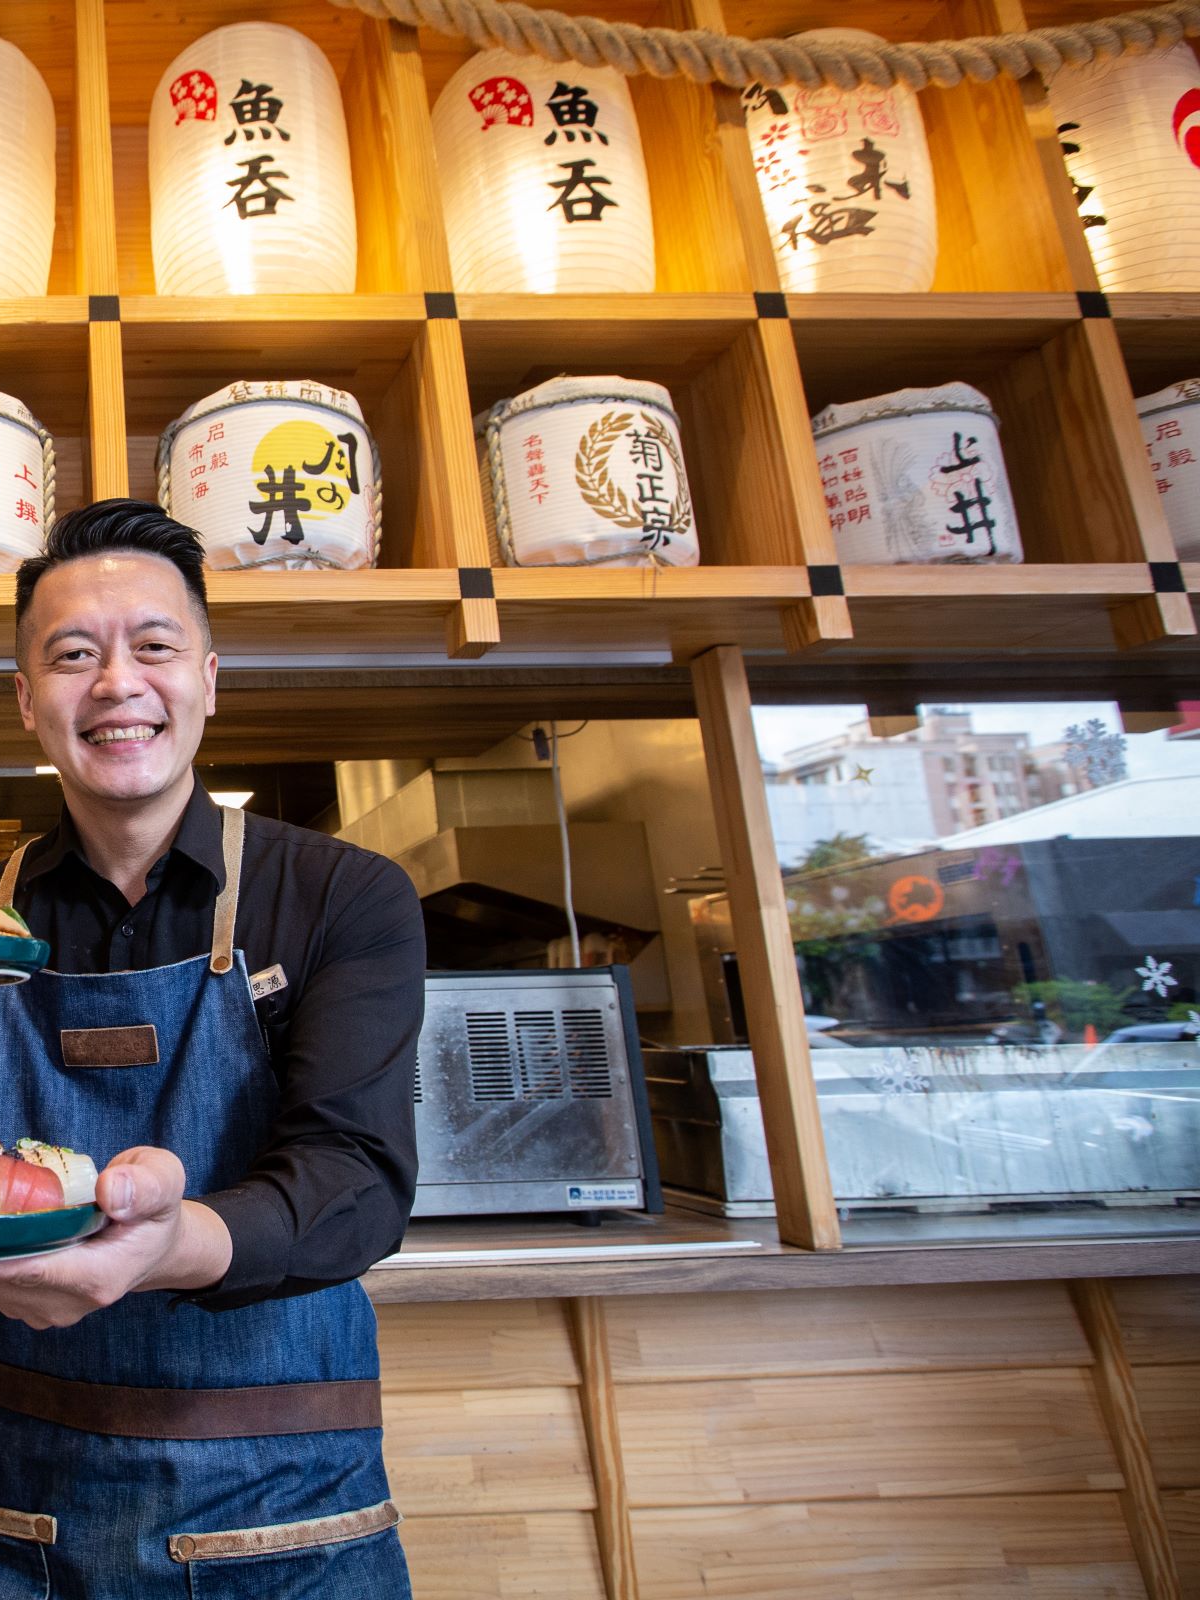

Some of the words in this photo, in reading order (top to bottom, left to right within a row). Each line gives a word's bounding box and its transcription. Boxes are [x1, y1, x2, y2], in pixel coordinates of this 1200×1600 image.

[14, 464, 39, 527] 上撰
[625, 429, 675, 551] 菊正宗
